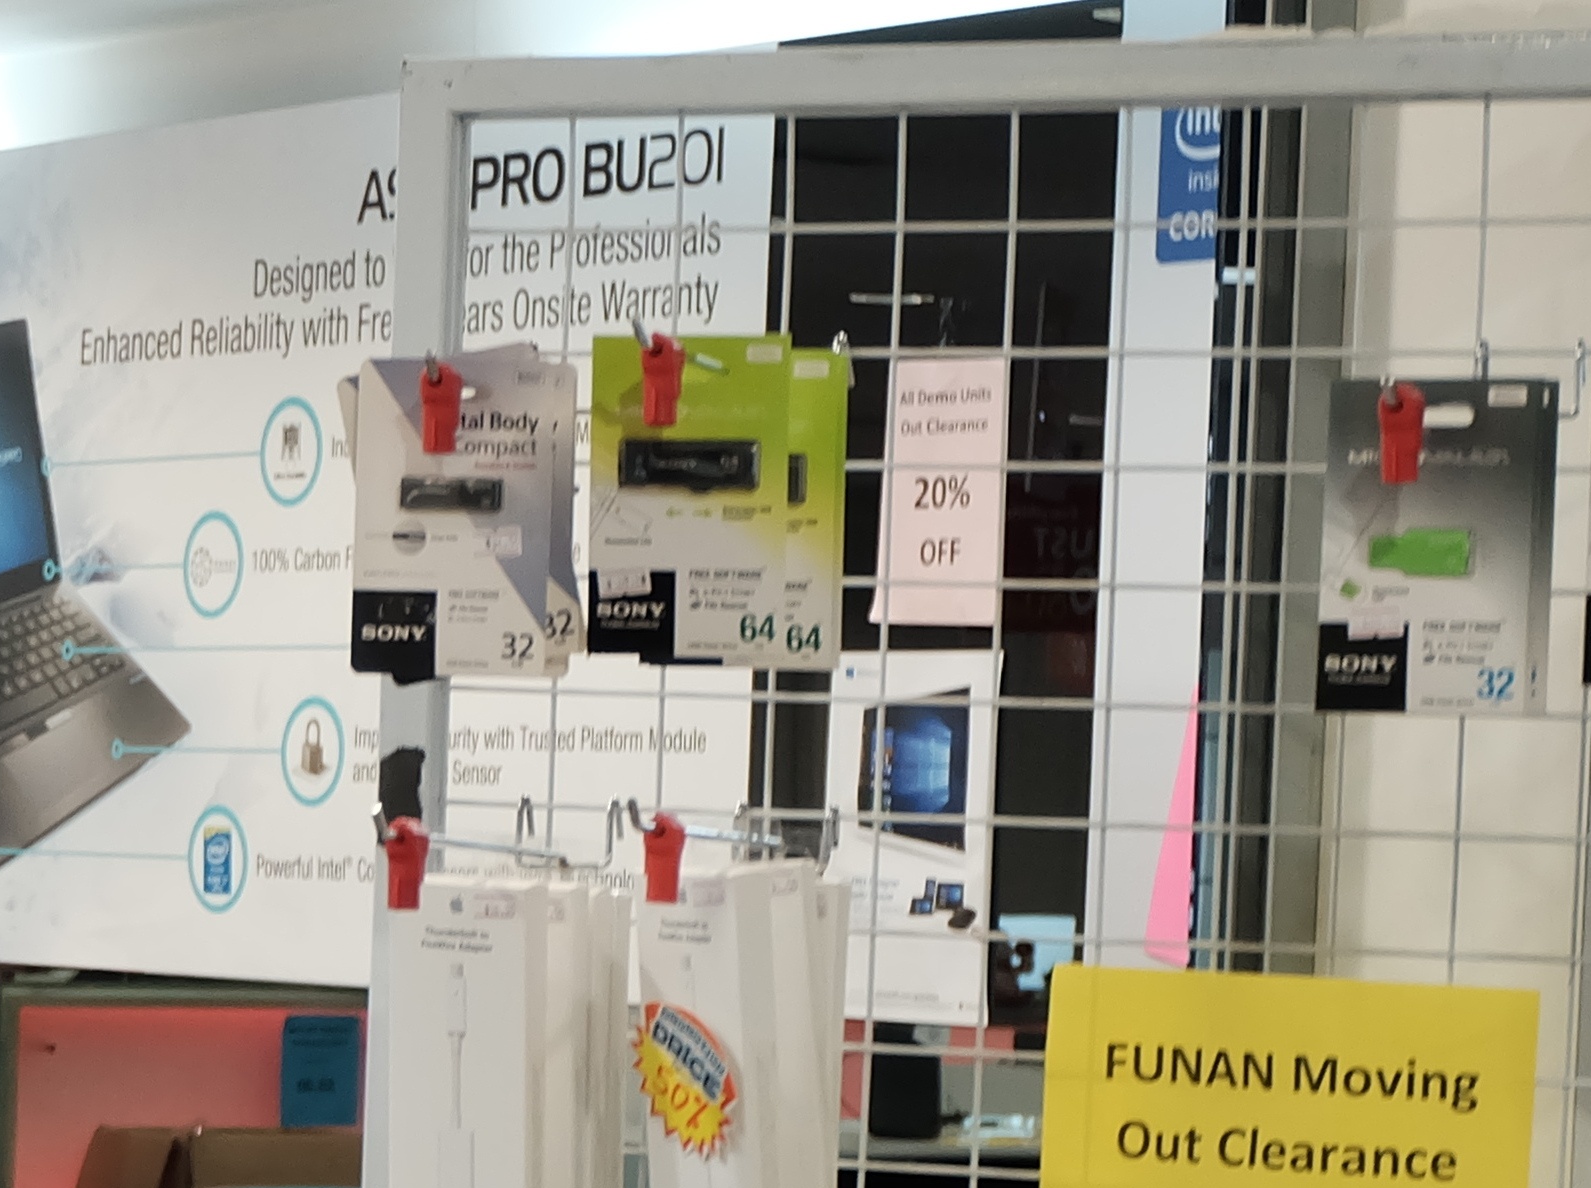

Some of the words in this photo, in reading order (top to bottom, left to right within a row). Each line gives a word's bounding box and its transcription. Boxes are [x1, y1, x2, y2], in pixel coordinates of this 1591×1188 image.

[471, 147, 565, 210] PRO
[253, 250, 356, 303] Designed
[365, 249, 386, 289] to
[502, 233, 540, 274] the
[80, 320, 183, 366] Enhanced
[191, 311, 295, 359] Reliability
[302, 306, 349, 347] with
[601, 272, 720, 325] Warranty
[900, 387, 915, 406] All
[918, 388, 957, 405] Demo
[961, 386, 992, 402] Units
[490, 411, 540, 436] Body
[900, 418, 922, 436] Out
[926, 416, 989, 436] Clearance
[458, 437, 537, 459] ompact
[914, 473, 971, 510] 20%
[252, 549, 289, 572] 100%
[294, 546, 341, 571] Carbon
[919, 537, 961, 568] OFF
[596, 601, 666, 620] SONY
[361, 622, 428, 643] SONY
[740, 612, 776, 644] 64
[786, 622, 822, 653] 64
[502, 632, 535, 660] 32
[1324, 653, 1398, 674] SONY
[1477, 667, 1516, 701] 32
[484, 726, 515, 751] with
[581, 725, 643, 752] Platform
[352, 762, 377, 783] and
[452, 759, 503, 786] Sensor
[256, 853, 313, 879] Powerful
[1105, 1041, 1274, 1090] FUNAN
[1292, 1053, 1480, 1113] Moving
[1116, 1119, 1203, 1165] Out
[1216, 1126, 1458, 1182] Clearance
